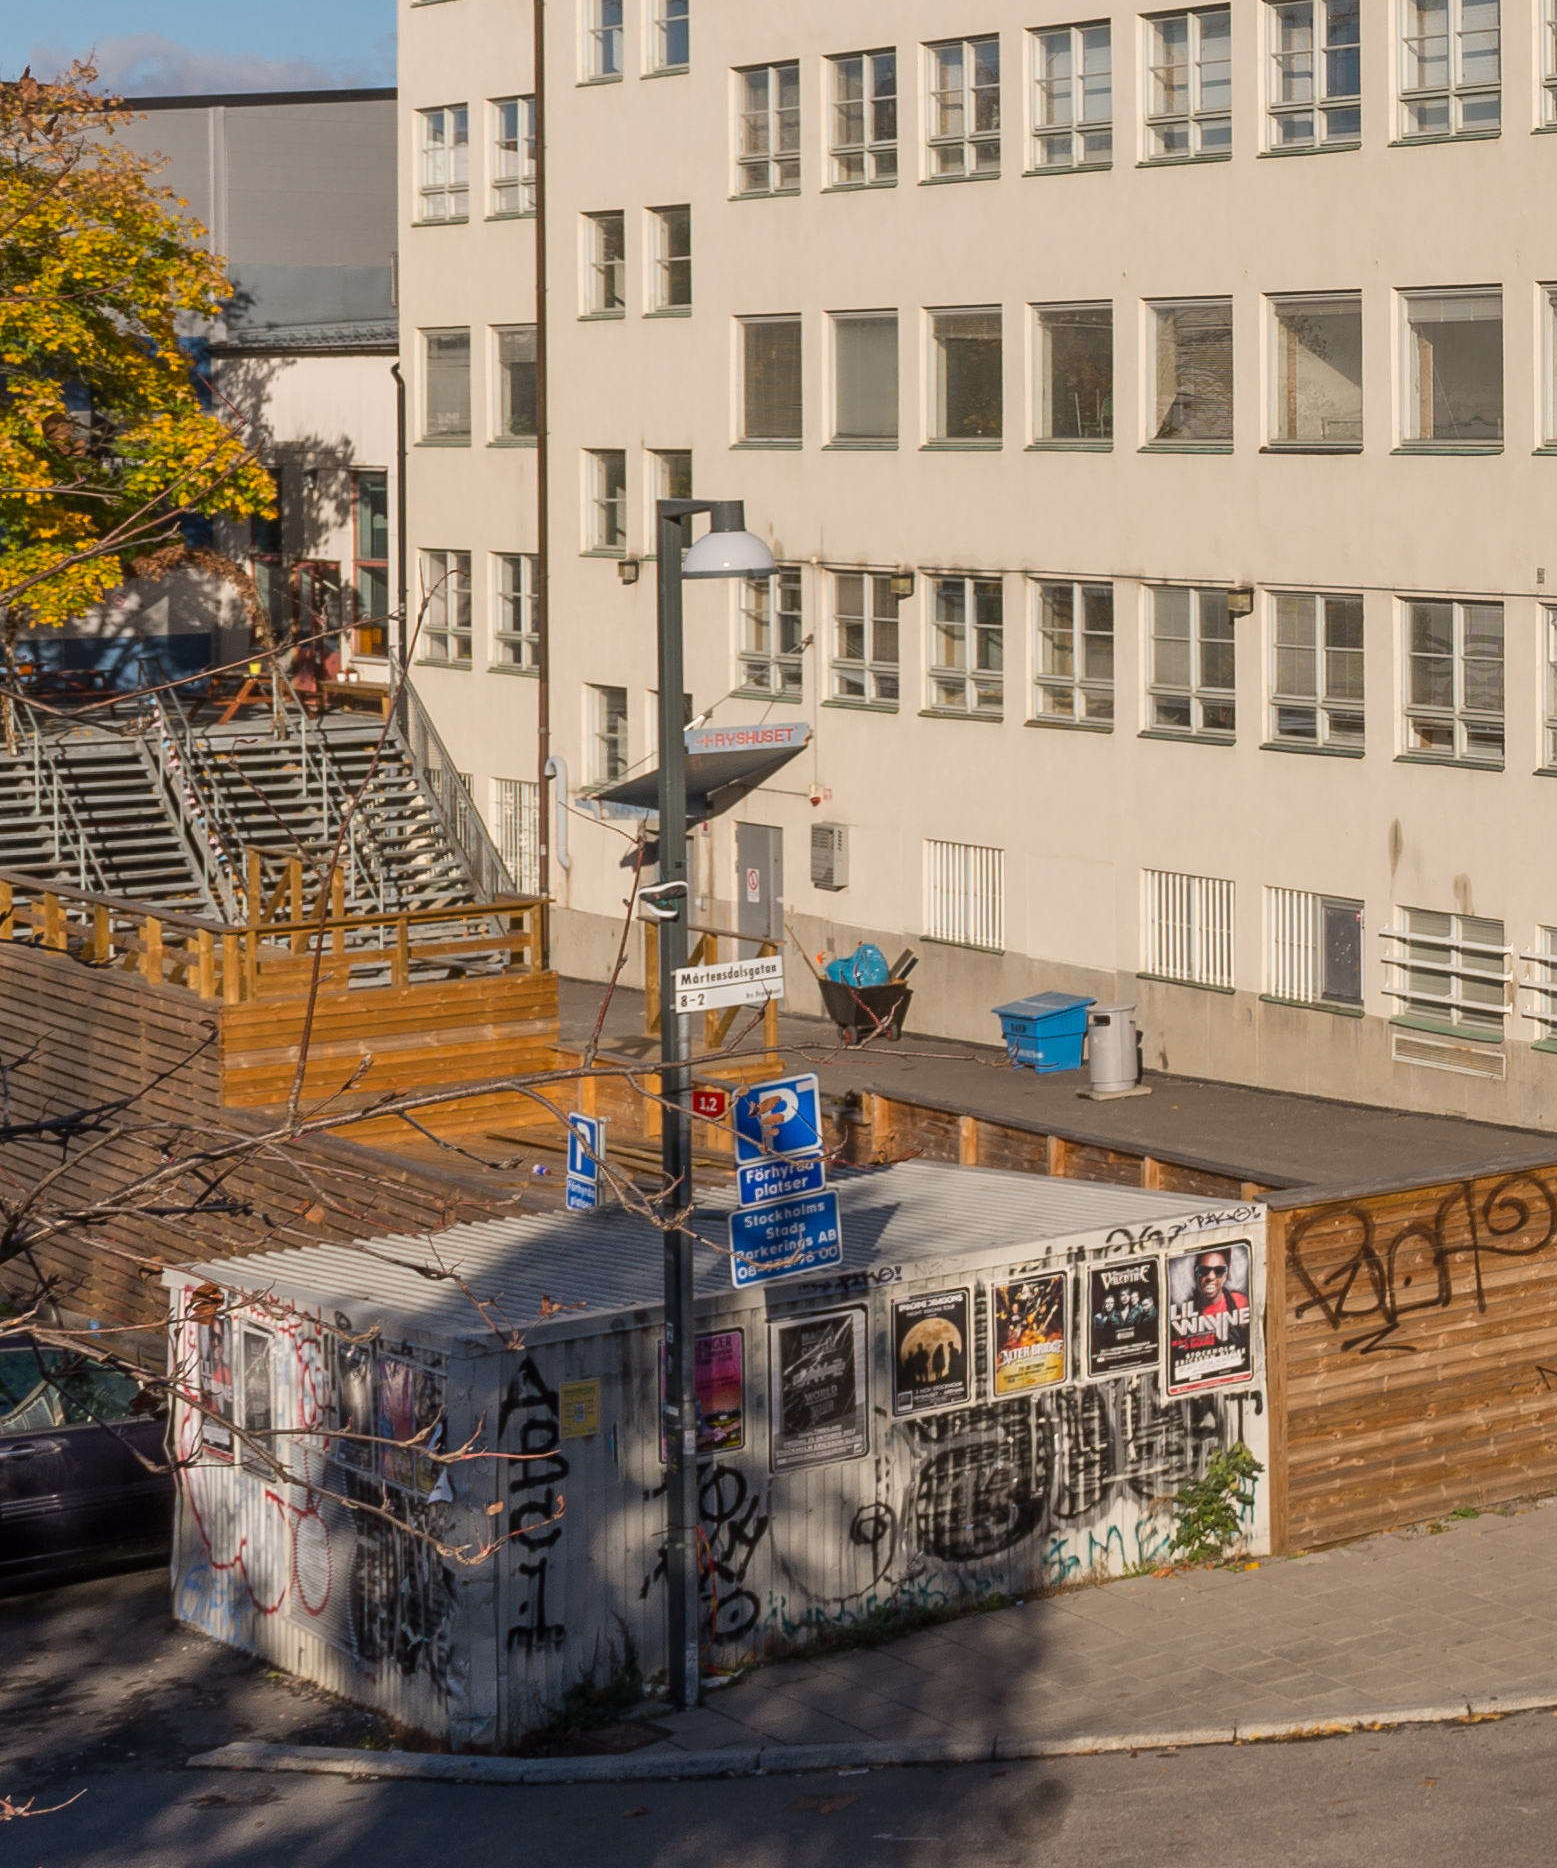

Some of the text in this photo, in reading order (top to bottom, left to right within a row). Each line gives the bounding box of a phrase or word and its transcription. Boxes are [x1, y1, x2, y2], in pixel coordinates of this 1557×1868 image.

[680, 962, 777, 986] Mårtensdalsgatan
[680, 993, 706, 1008] 8-2
[754, 1176, 809, 1201] platser
[743, 1199, 826, 1229] Stockholms
[765, 1221, 806, 1240] Stads
[817, 1228, 837, 1243] AB
[1170, 1300, 1199, 1321] LIL
[1171, 1306, 1251, 1342] WAYNE
